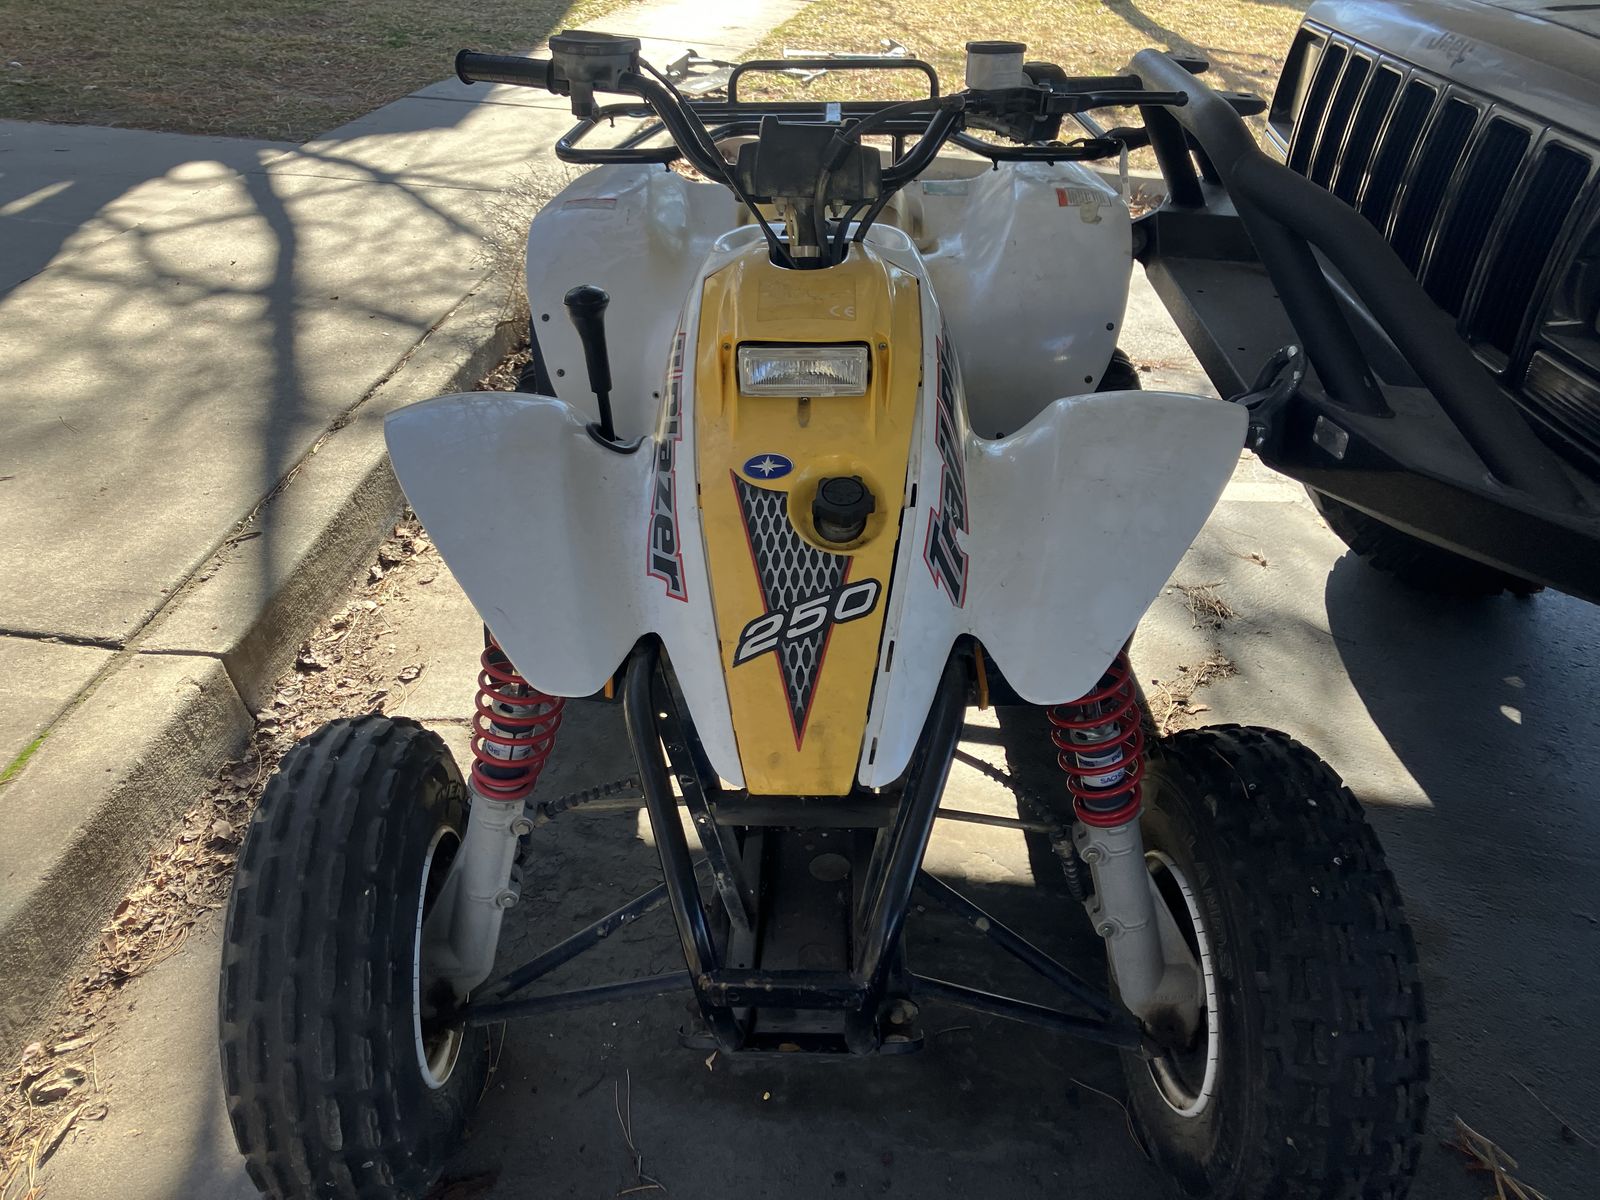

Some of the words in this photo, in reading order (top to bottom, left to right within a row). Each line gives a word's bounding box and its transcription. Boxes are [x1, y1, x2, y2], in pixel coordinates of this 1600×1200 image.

[1426, 31, 1474, 69] Jeep
[829, 304, 856, 318] CE
[735, 579, 881, 664] 250
